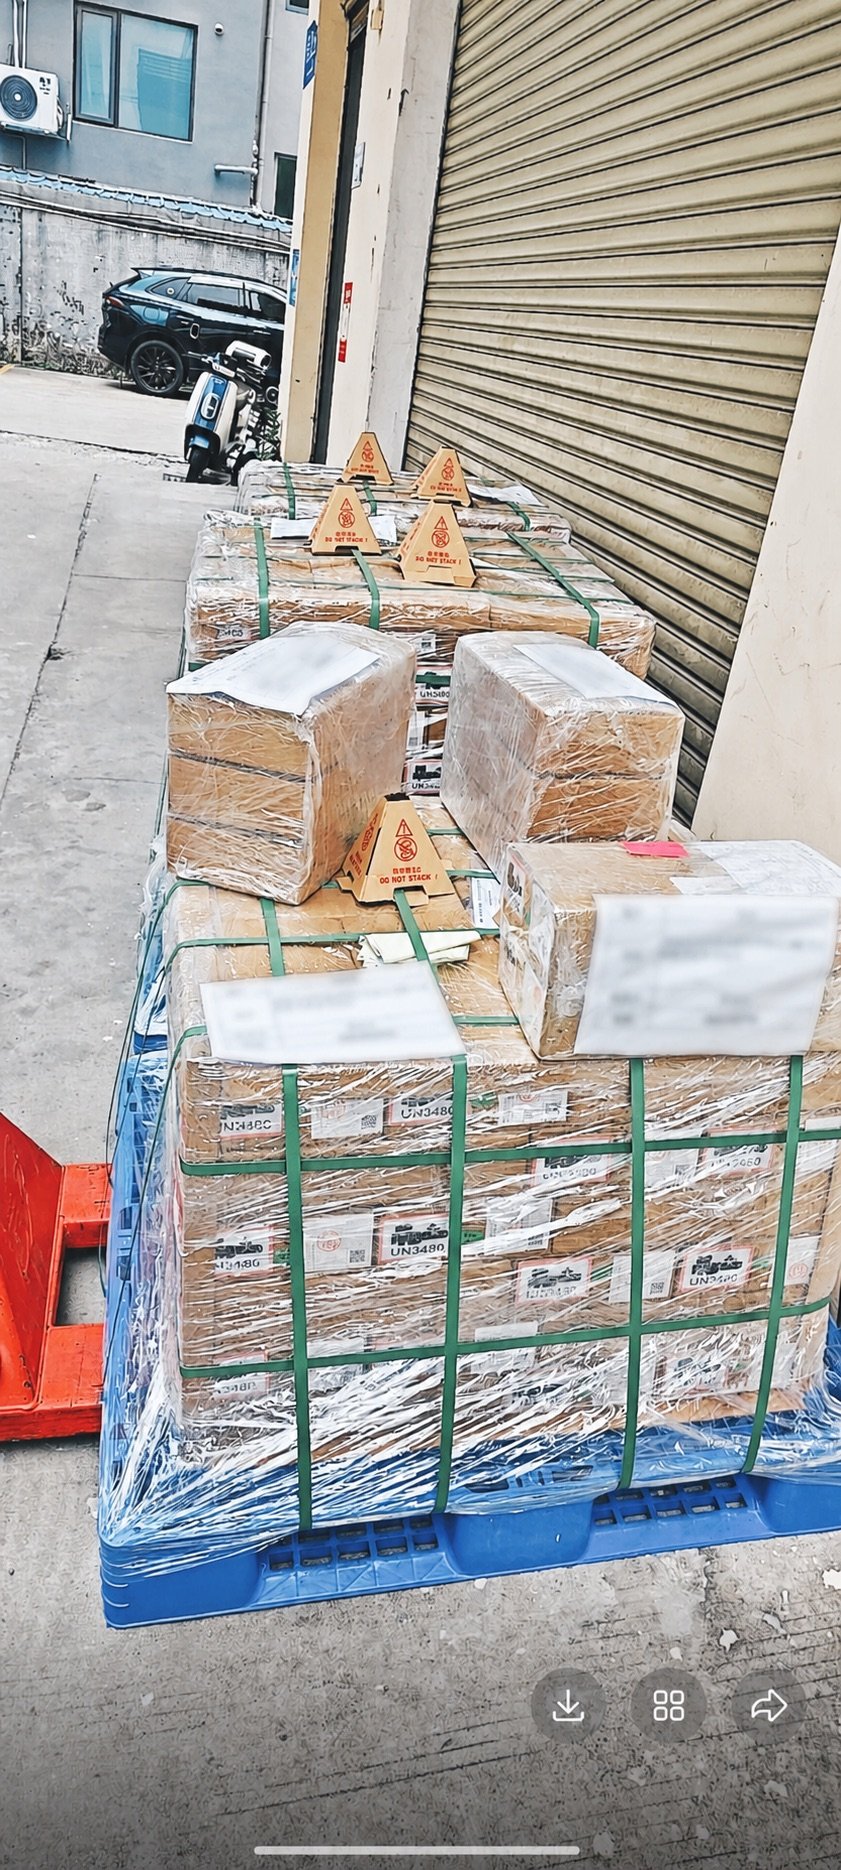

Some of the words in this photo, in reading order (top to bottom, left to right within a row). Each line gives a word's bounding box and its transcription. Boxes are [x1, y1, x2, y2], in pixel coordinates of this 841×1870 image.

[392, 875, 406, 883] NOT
[408, 873, 432, 882] STACK
[390, 1243, 445, 1256] UN3480
